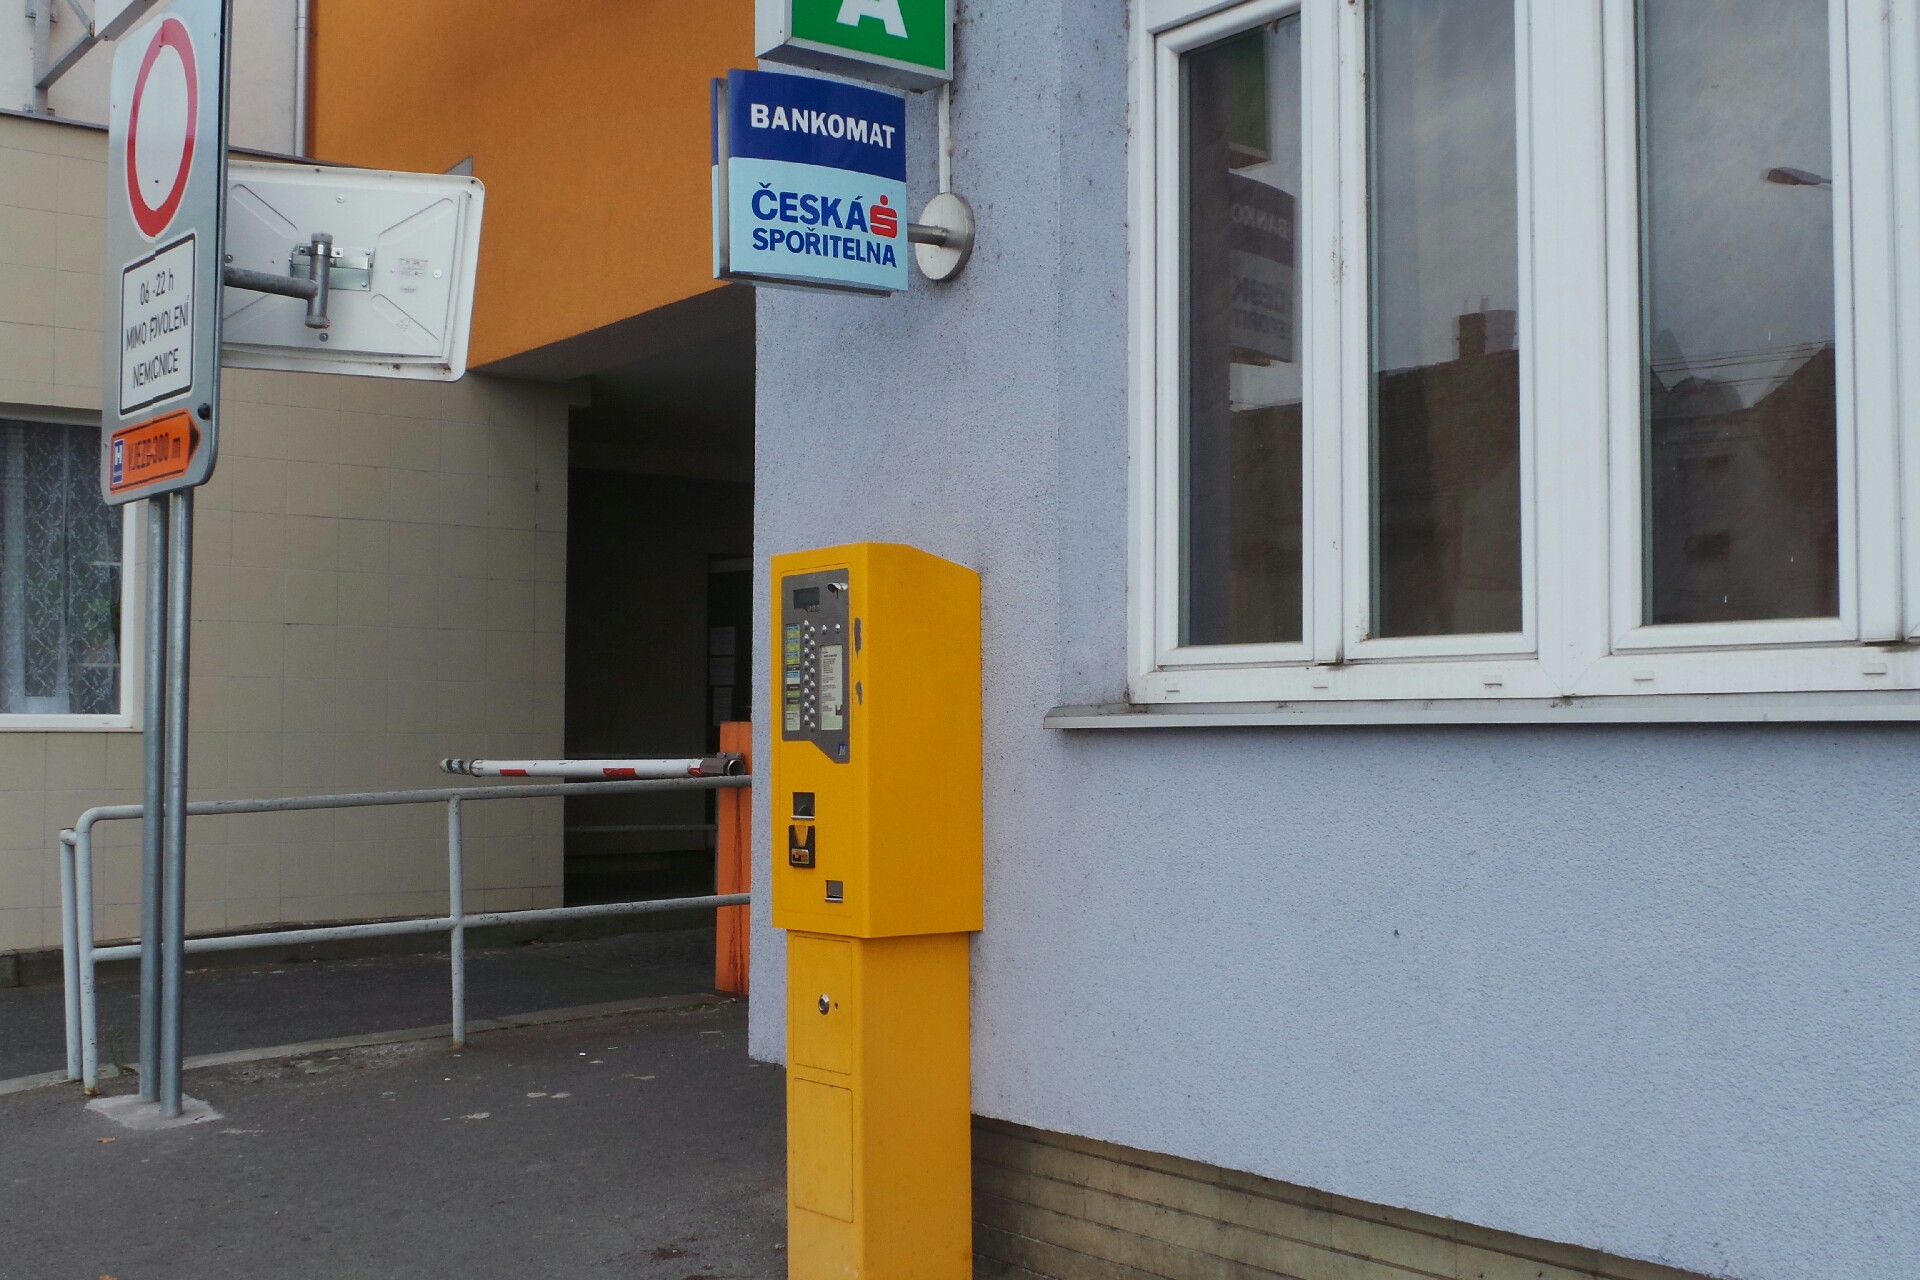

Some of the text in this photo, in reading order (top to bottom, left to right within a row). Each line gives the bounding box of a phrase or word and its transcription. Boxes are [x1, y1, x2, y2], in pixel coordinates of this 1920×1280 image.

[751, 103, 895, 148] BANKOMAT
[751, 182, 867, 233] ČESKÁ
[752, 227, 897, 267] SPOŘITELNA
[168, 267, 174, 291] h
[126, 321, 147, 351] MIMO
